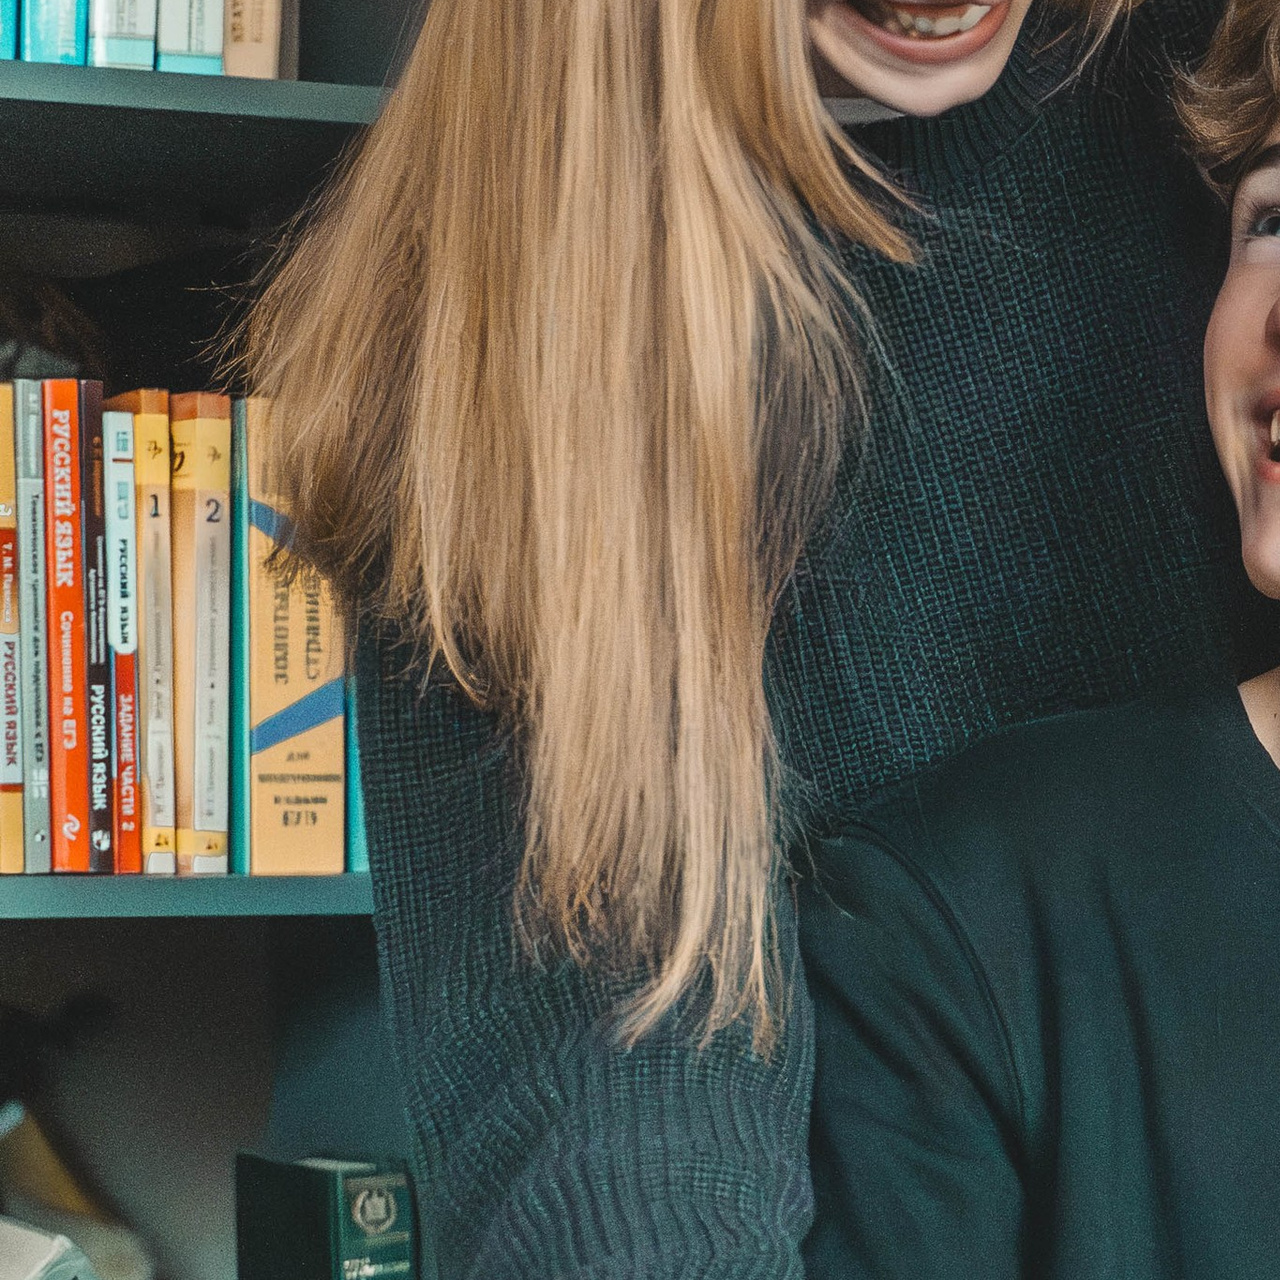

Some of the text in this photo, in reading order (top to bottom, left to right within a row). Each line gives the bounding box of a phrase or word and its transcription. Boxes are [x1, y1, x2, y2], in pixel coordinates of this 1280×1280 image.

[52, 409, 76, 587] РУССКИЙ ЯЗЫК
[150, 493, 161, 518] 1
[205, 498, 221, 523] 2
[119, 539, 129, 644] РУССКИЙ ЯЗЫК
[4, 641, 18, 767] РУССКИЙ ЯЗЫК
[60, 611, 77, 750] Сочинение на ЕГЭ
[90, 684, 109, 760] РУССКИЙ
[92, 762, 107, 811] ЯЗЫК
[119, 694, 135, 832] ЗАДАНИЕ ЧАСТИ 2
